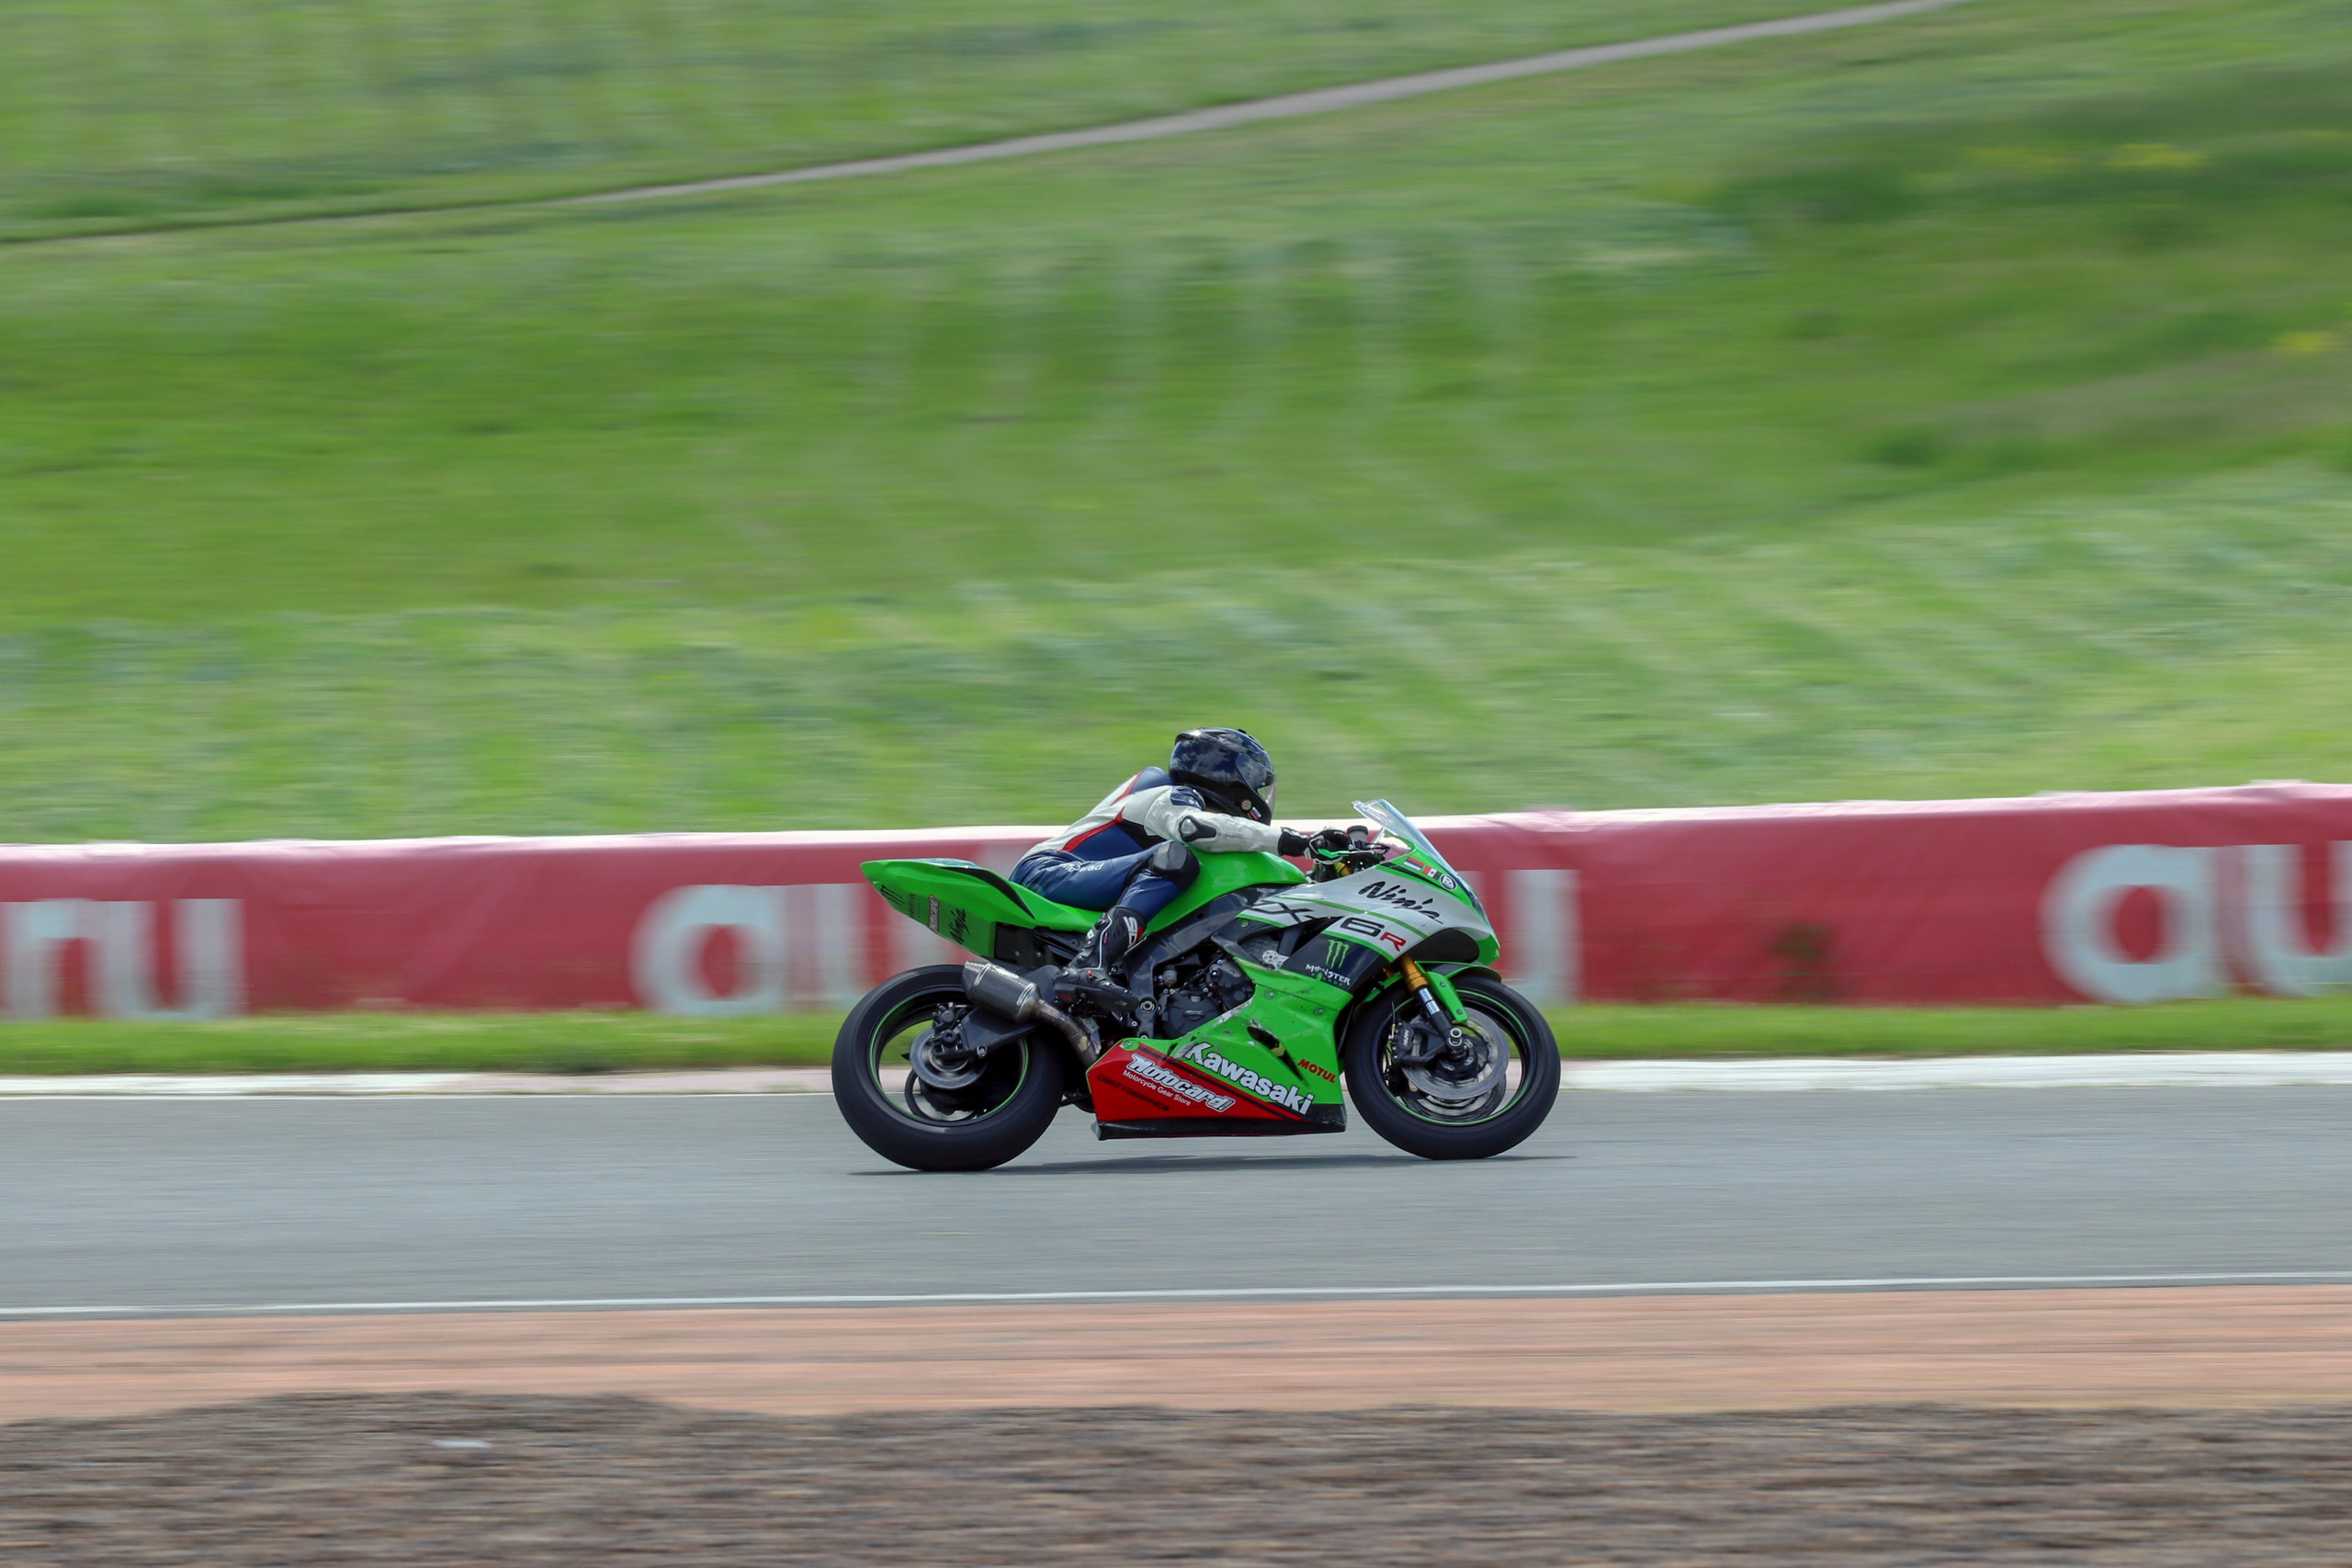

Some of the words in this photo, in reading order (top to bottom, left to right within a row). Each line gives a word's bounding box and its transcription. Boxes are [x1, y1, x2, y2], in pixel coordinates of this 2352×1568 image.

[1358, 881, 1443, 925] Ninja
[1306, 964, 1351, 986] MONSTER
[1122, 1069, 1157, 1091] Motorcycle
[1157, 1087, 1173, 1099] Gear
[1173, 1094, 1192, 1107] Store
[1184, 1042, 1316, 1115] Kawasaki
[1297, 1058, 1336, 1083] MOTUL
